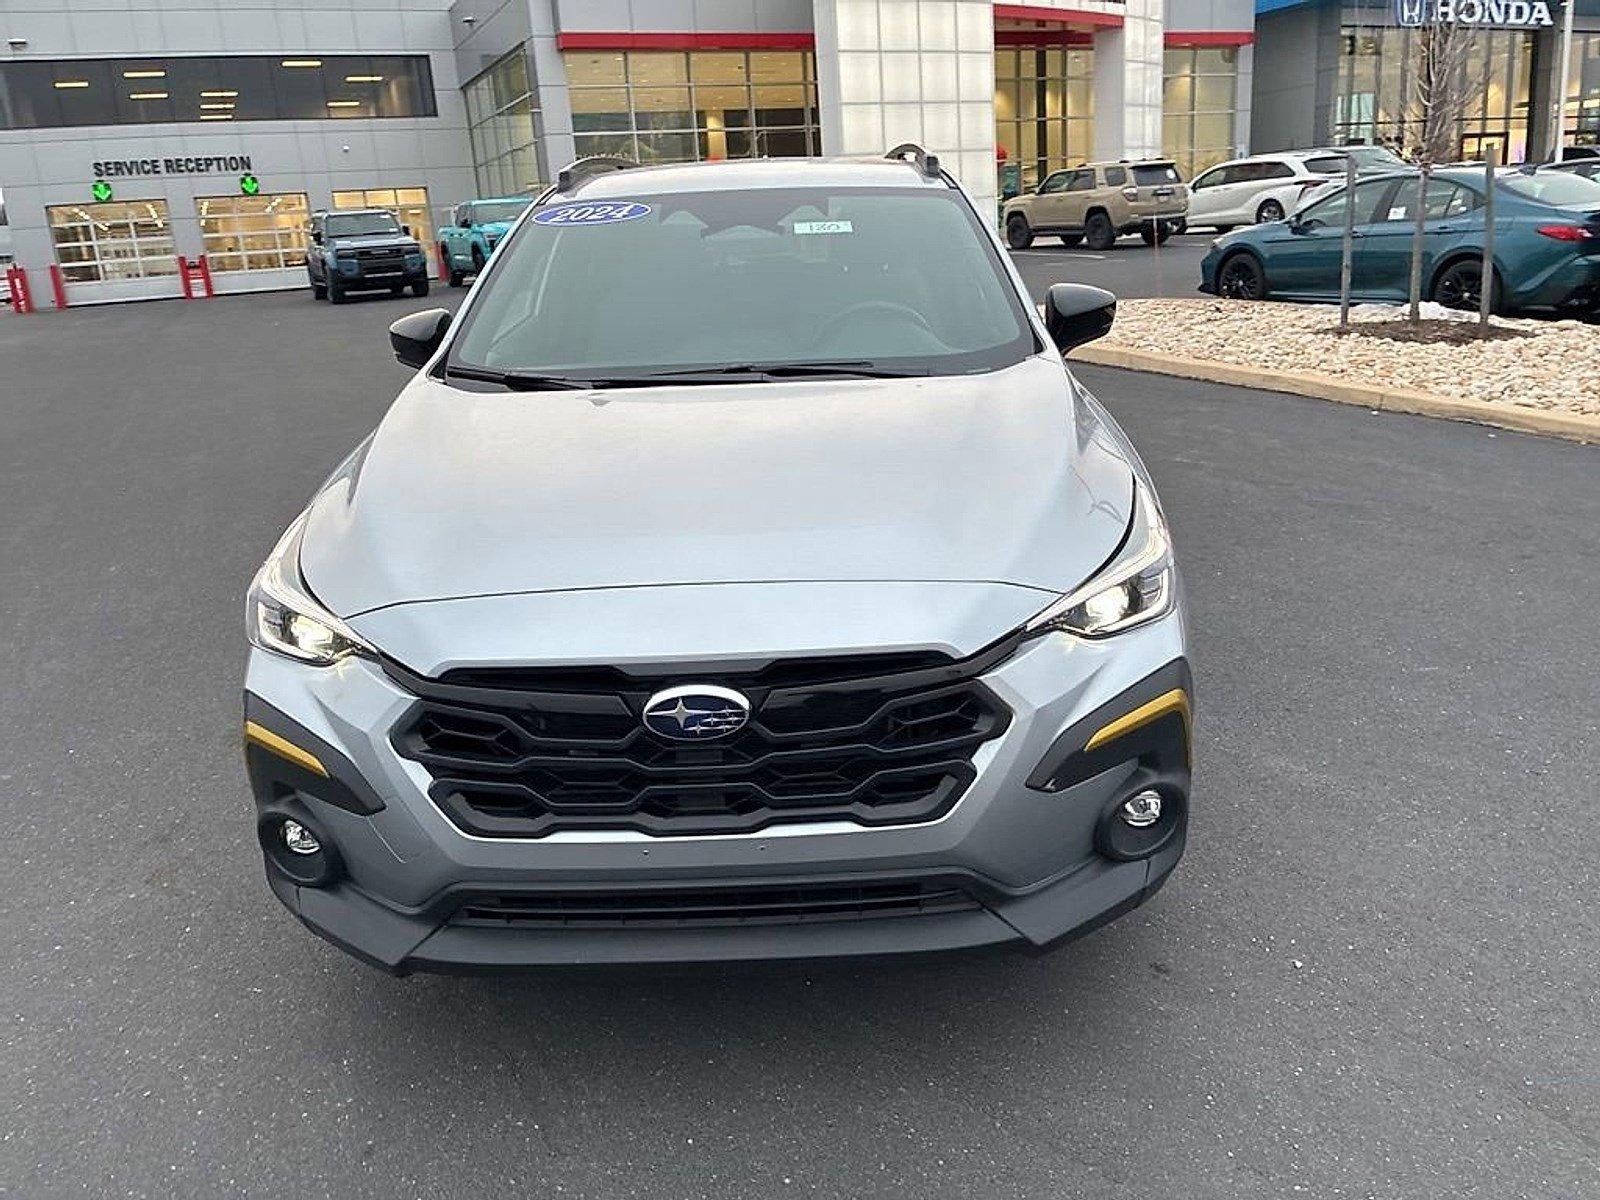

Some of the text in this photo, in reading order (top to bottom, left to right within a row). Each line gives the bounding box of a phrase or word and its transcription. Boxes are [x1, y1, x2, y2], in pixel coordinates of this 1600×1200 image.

[1430, 0, 1553, 26] HONDA
[93, 156, 252, 177] SERVICE RECEPTION
[549, 203, 636, 221] 2024
